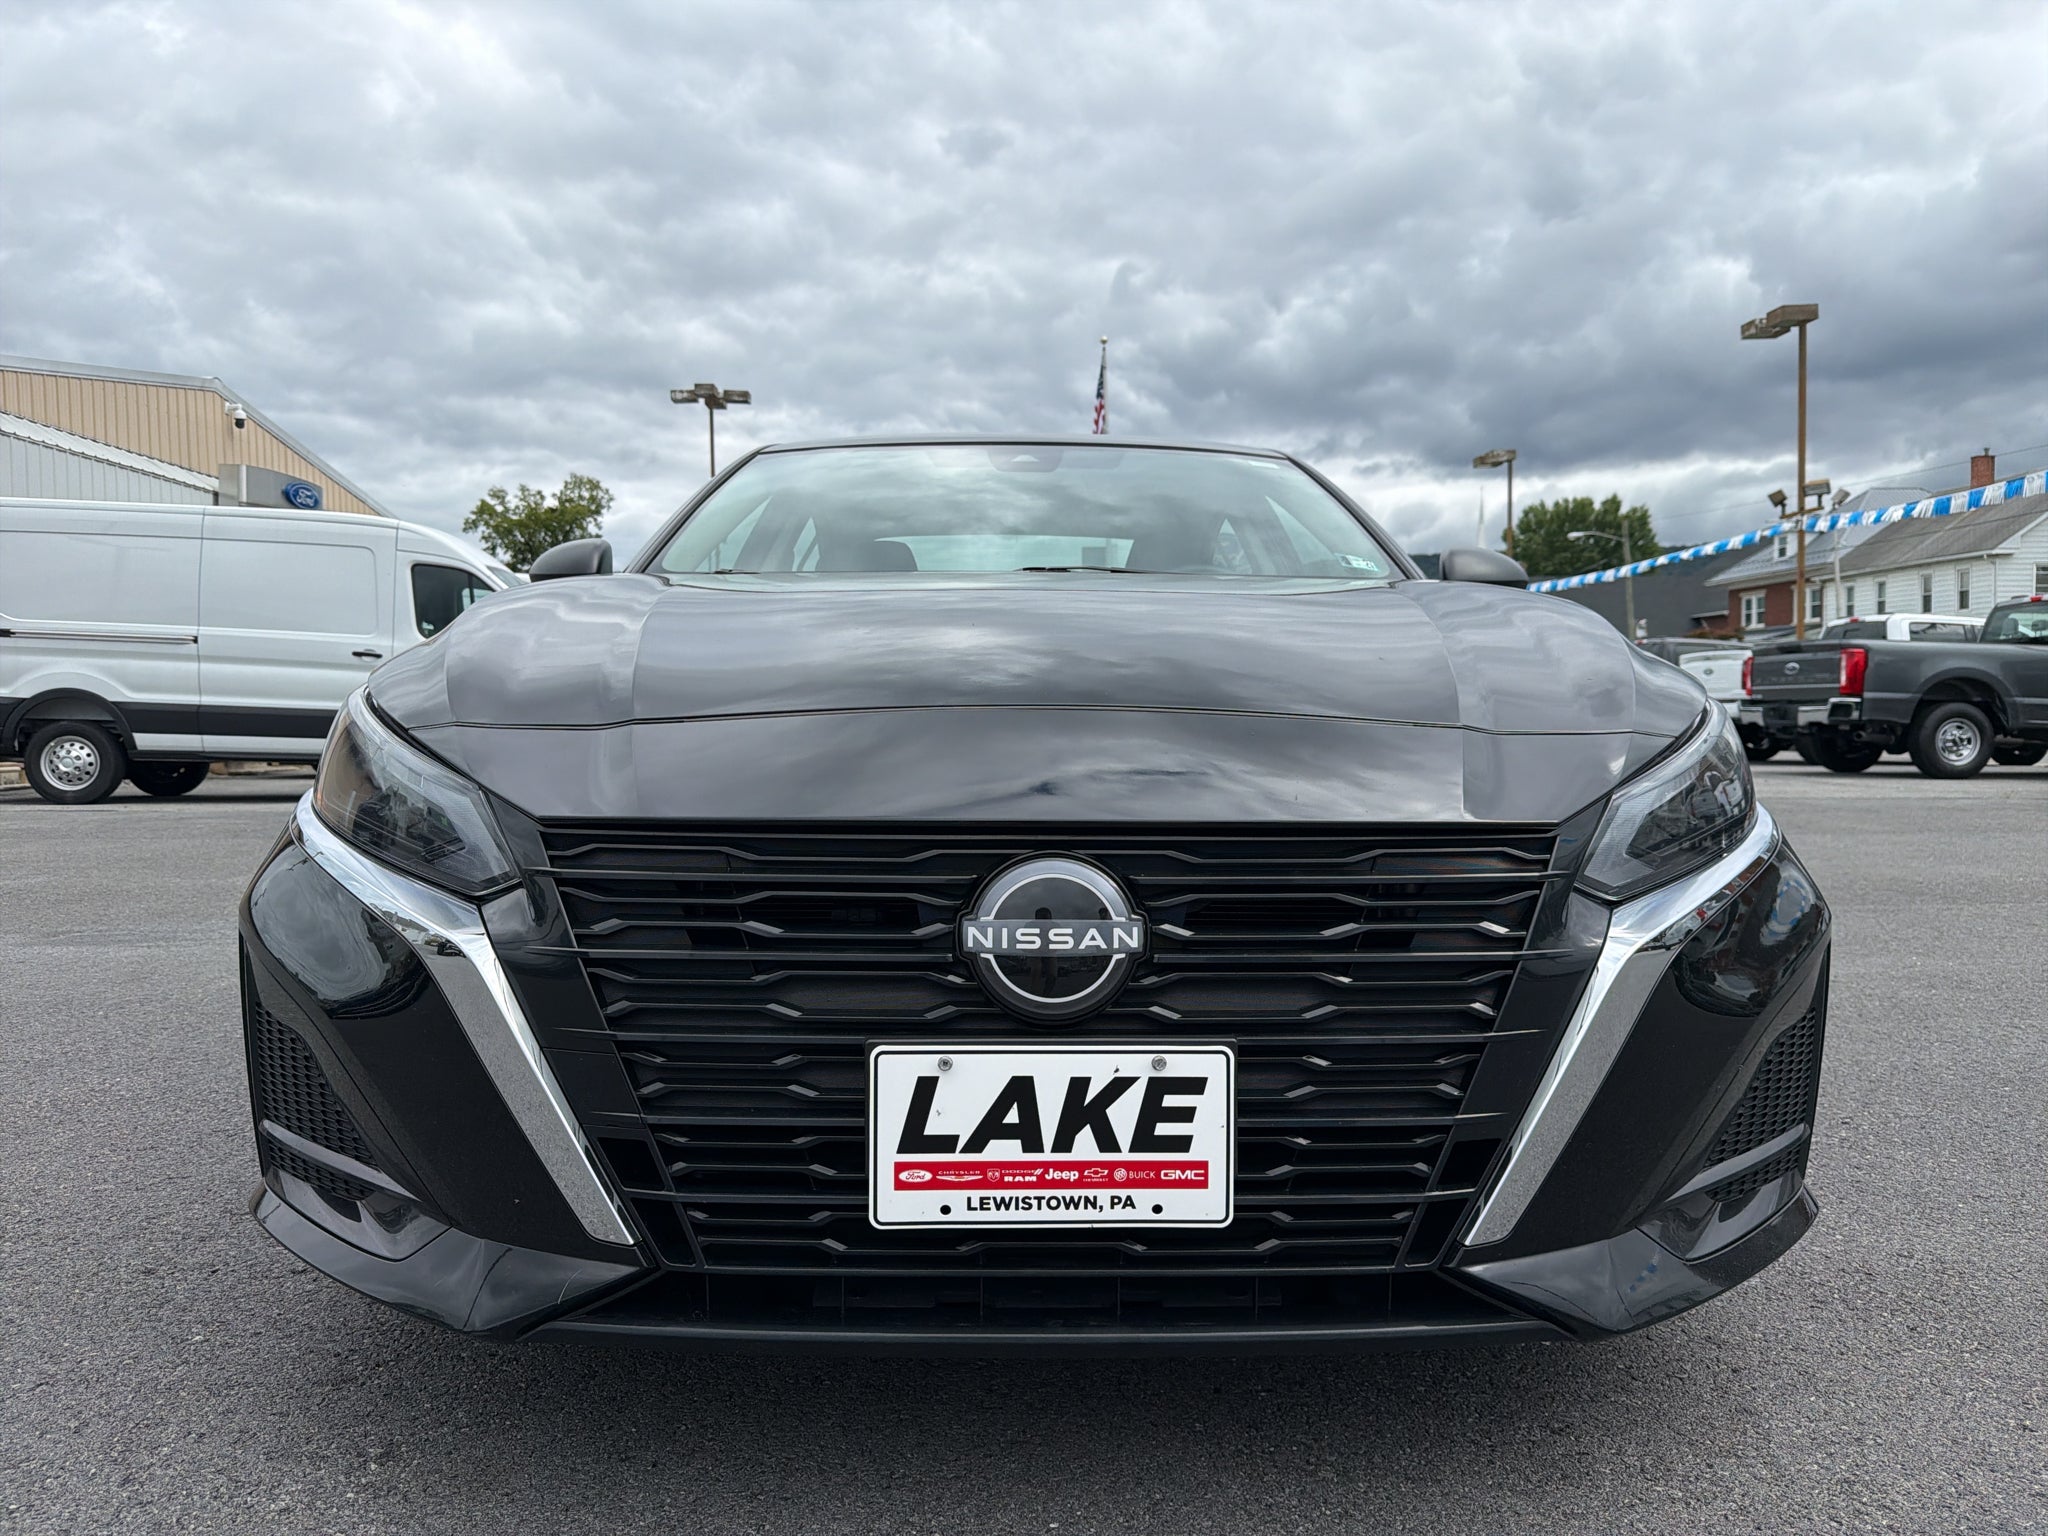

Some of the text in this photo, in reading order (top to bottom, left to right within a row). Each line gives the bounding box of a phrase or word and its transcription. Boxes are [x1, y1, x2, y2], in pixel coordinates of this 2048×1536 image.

[295, 488, 316, 507] Ford
[967, 926, 1139, 950] NISSAN
[896, 1075, 1209, 1154] LAKE
[905, 1171, 926, 1180] Ford
[1044, 1168, 1079, 1182] Jeep
[1129, 1170, 1156, 1179] BUICK
[1160, 1169, 1205, 1180] GMC
[966, 1195, 1137, 1213] LEWISTOWN, PA
